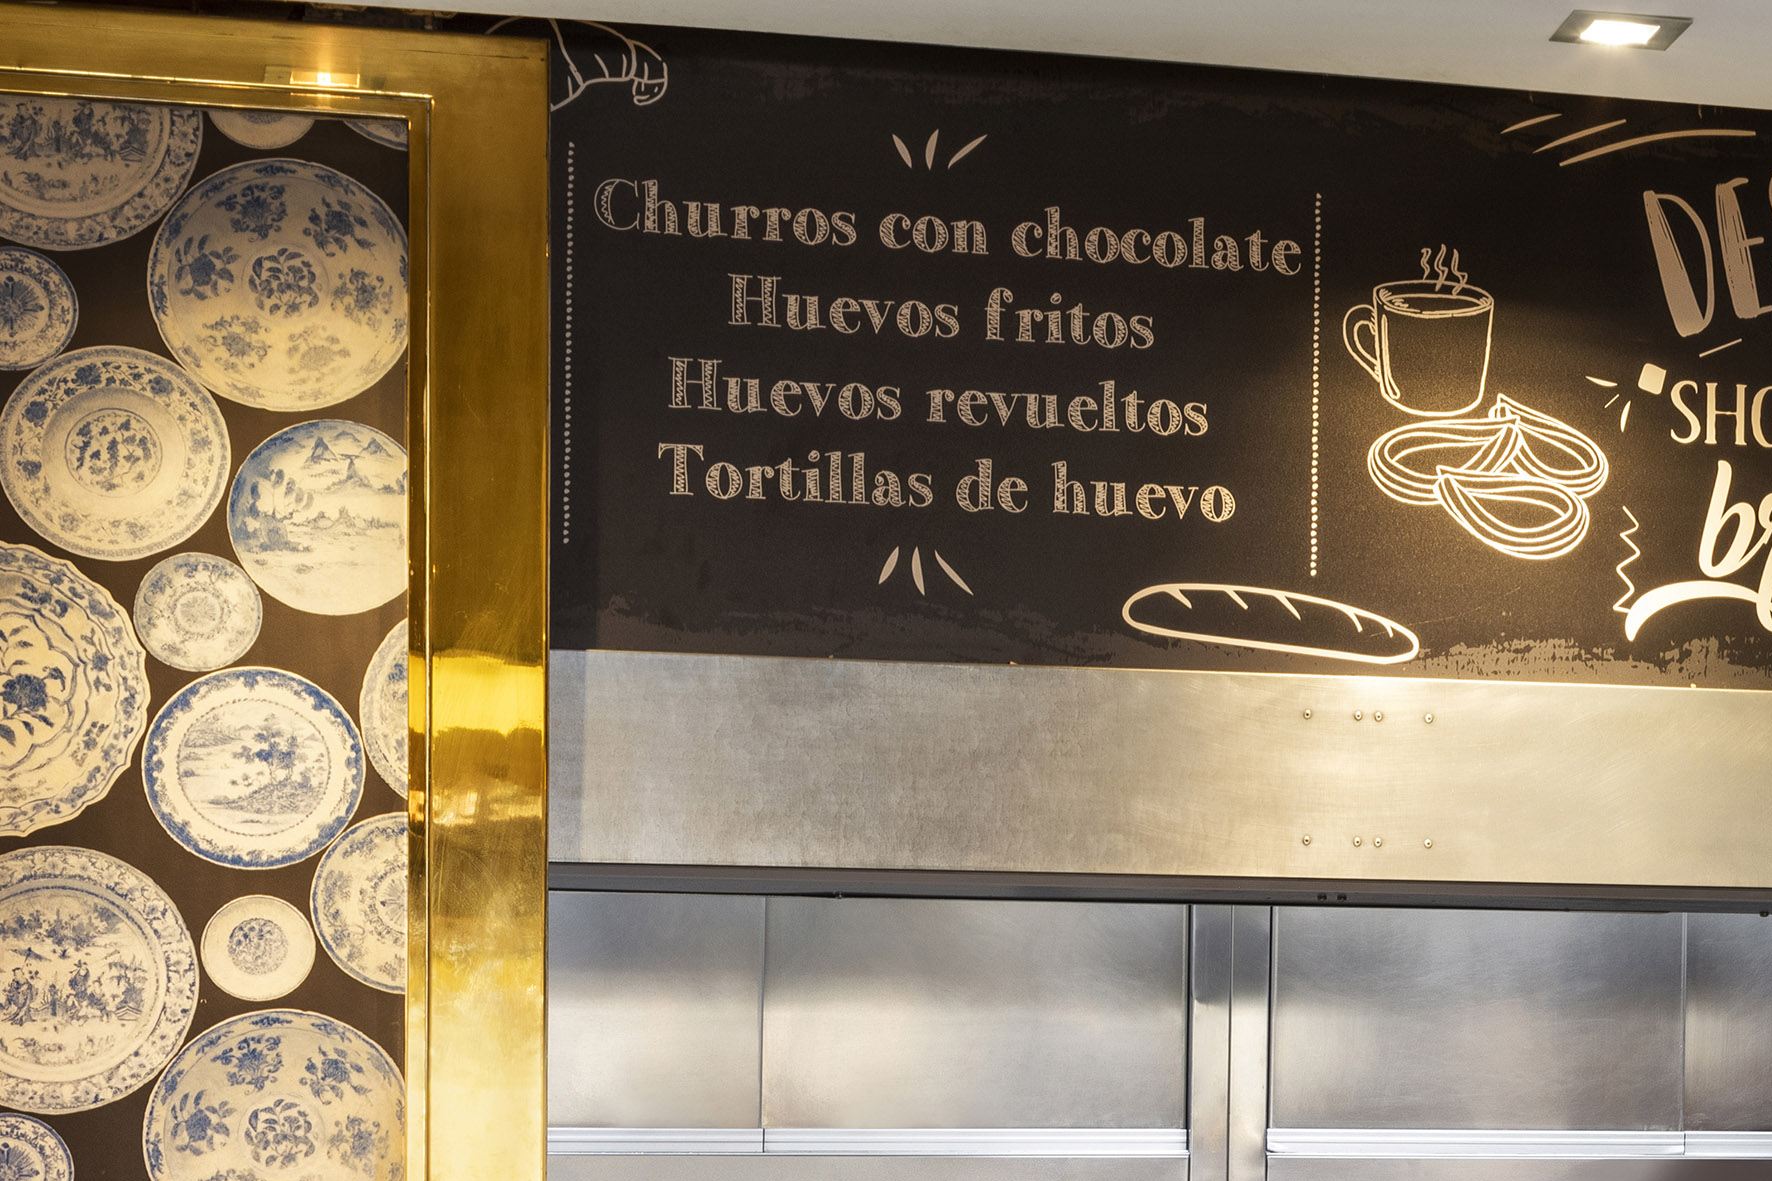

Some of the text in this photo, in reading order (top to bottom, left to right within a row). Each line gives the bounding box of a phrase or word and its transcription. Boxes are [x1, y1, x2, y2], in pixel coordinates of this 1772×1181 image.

[594, 178, 1302, 276] Churros con chocolate
[728, 272, 1155, 349] Huevos fritos
[667, 356, 1209, 437] Huevos revueltos
[658, 441, 1236, 523] Tortillas de huevo
